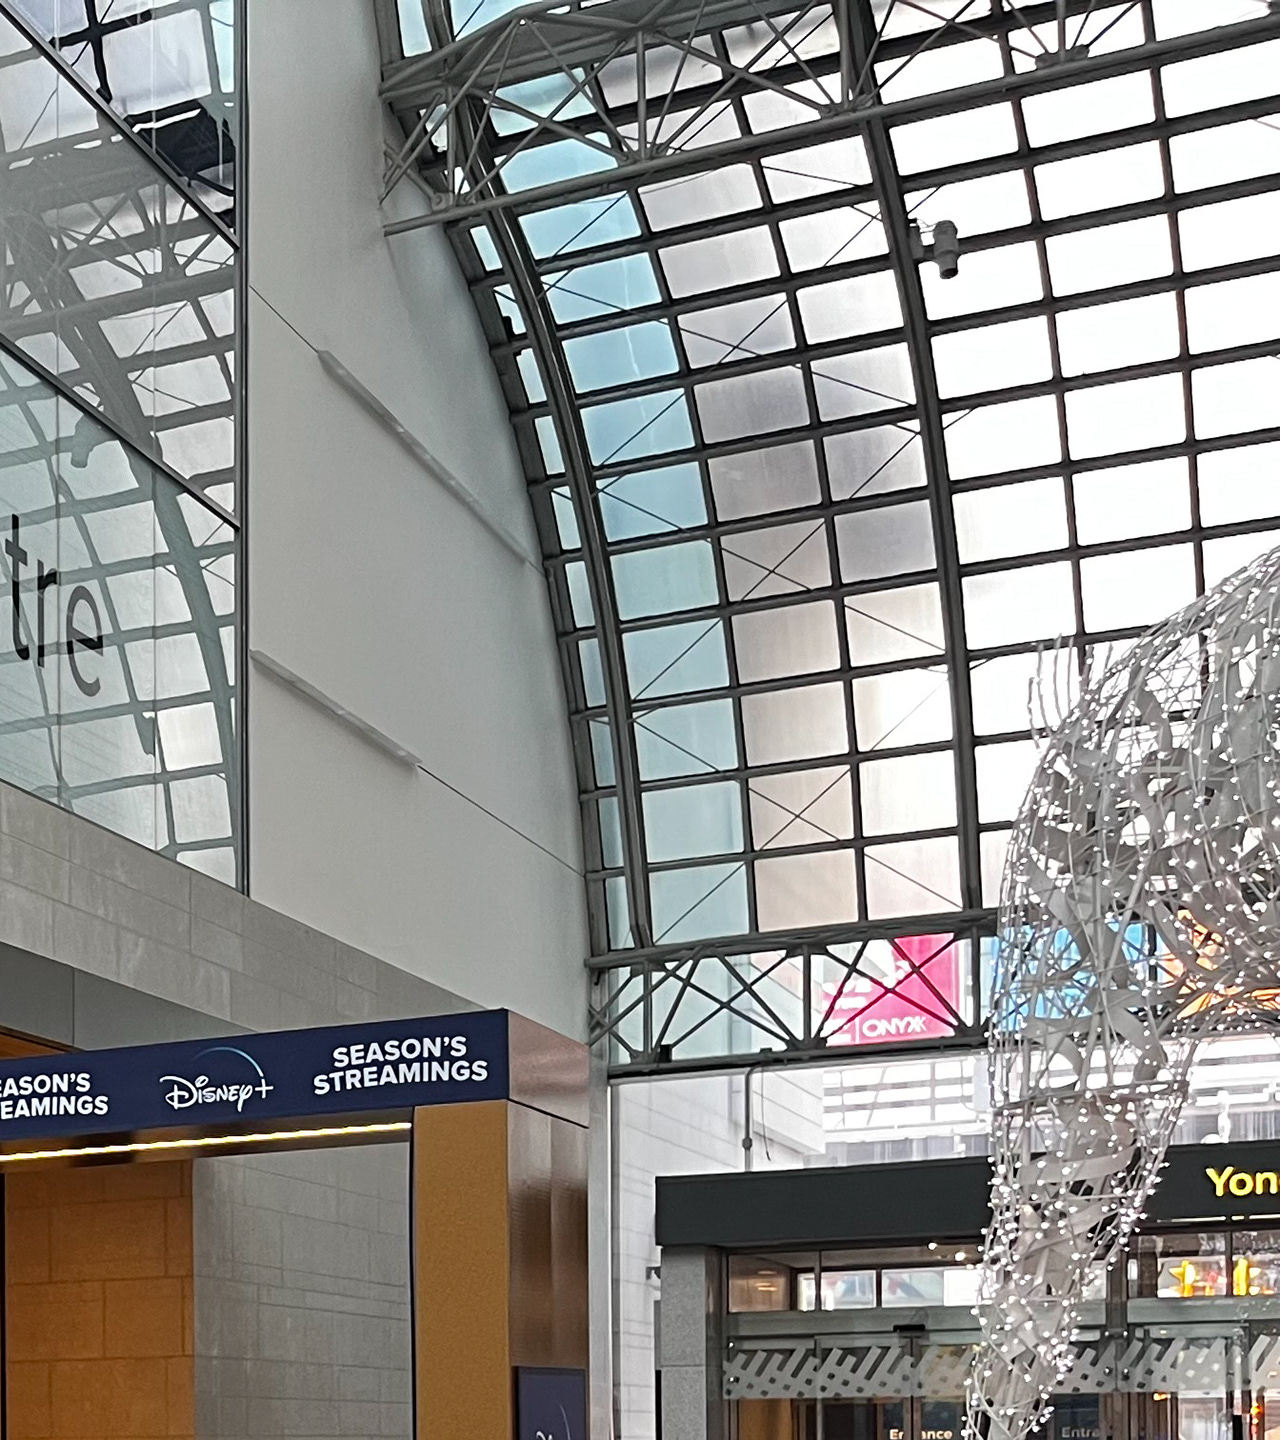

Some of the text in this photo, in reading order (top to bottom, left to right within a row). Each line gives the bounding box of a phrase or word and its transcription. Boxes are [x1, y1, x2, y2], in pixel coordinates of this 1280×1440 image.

[333, 1036, 467, 1067] SEASON'S
[159, 1074, 274, 1112] Disney+
[313, 1060, 488, 1095] STREAMINGS
[1206, 1166, 1280, 1197] Yon
